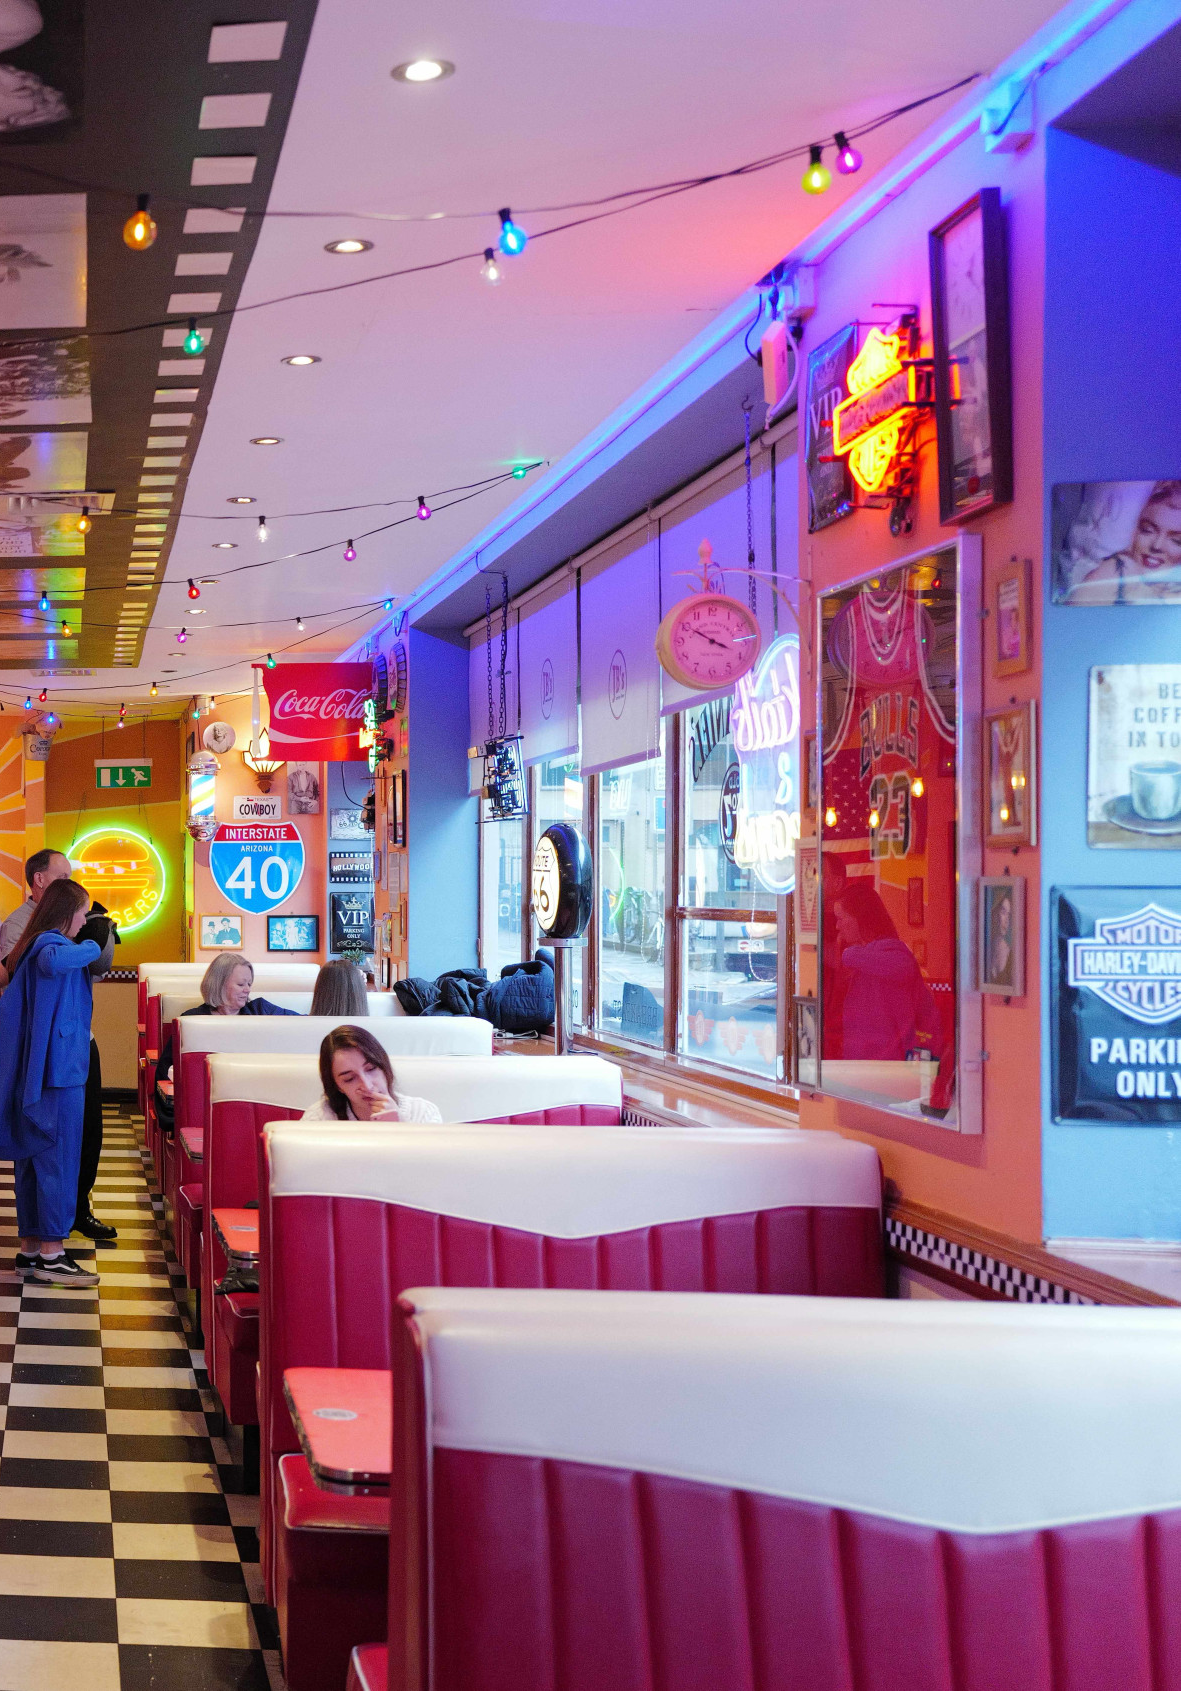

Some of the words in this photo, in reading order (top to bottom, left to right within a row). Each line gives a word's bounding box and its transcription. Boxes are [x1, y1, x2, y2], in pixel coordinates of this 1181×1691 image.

[811, 387, 842, 441] VIP
[274, 688, 373, 720] Coca-Cola
[860, 693, 919, 782] BULLS
[239, 804, 277, 815] COWBOY
[870, 771, 912, 859] 23
[226, 828, 288, 839] INTERSTATE
[240, 845, 274, 853] ARIZONA
[225, 856, 289, 900] 40
[333, 863, 374, 872] HOLLYWOO
[337, 911, 370, 925] VIP
